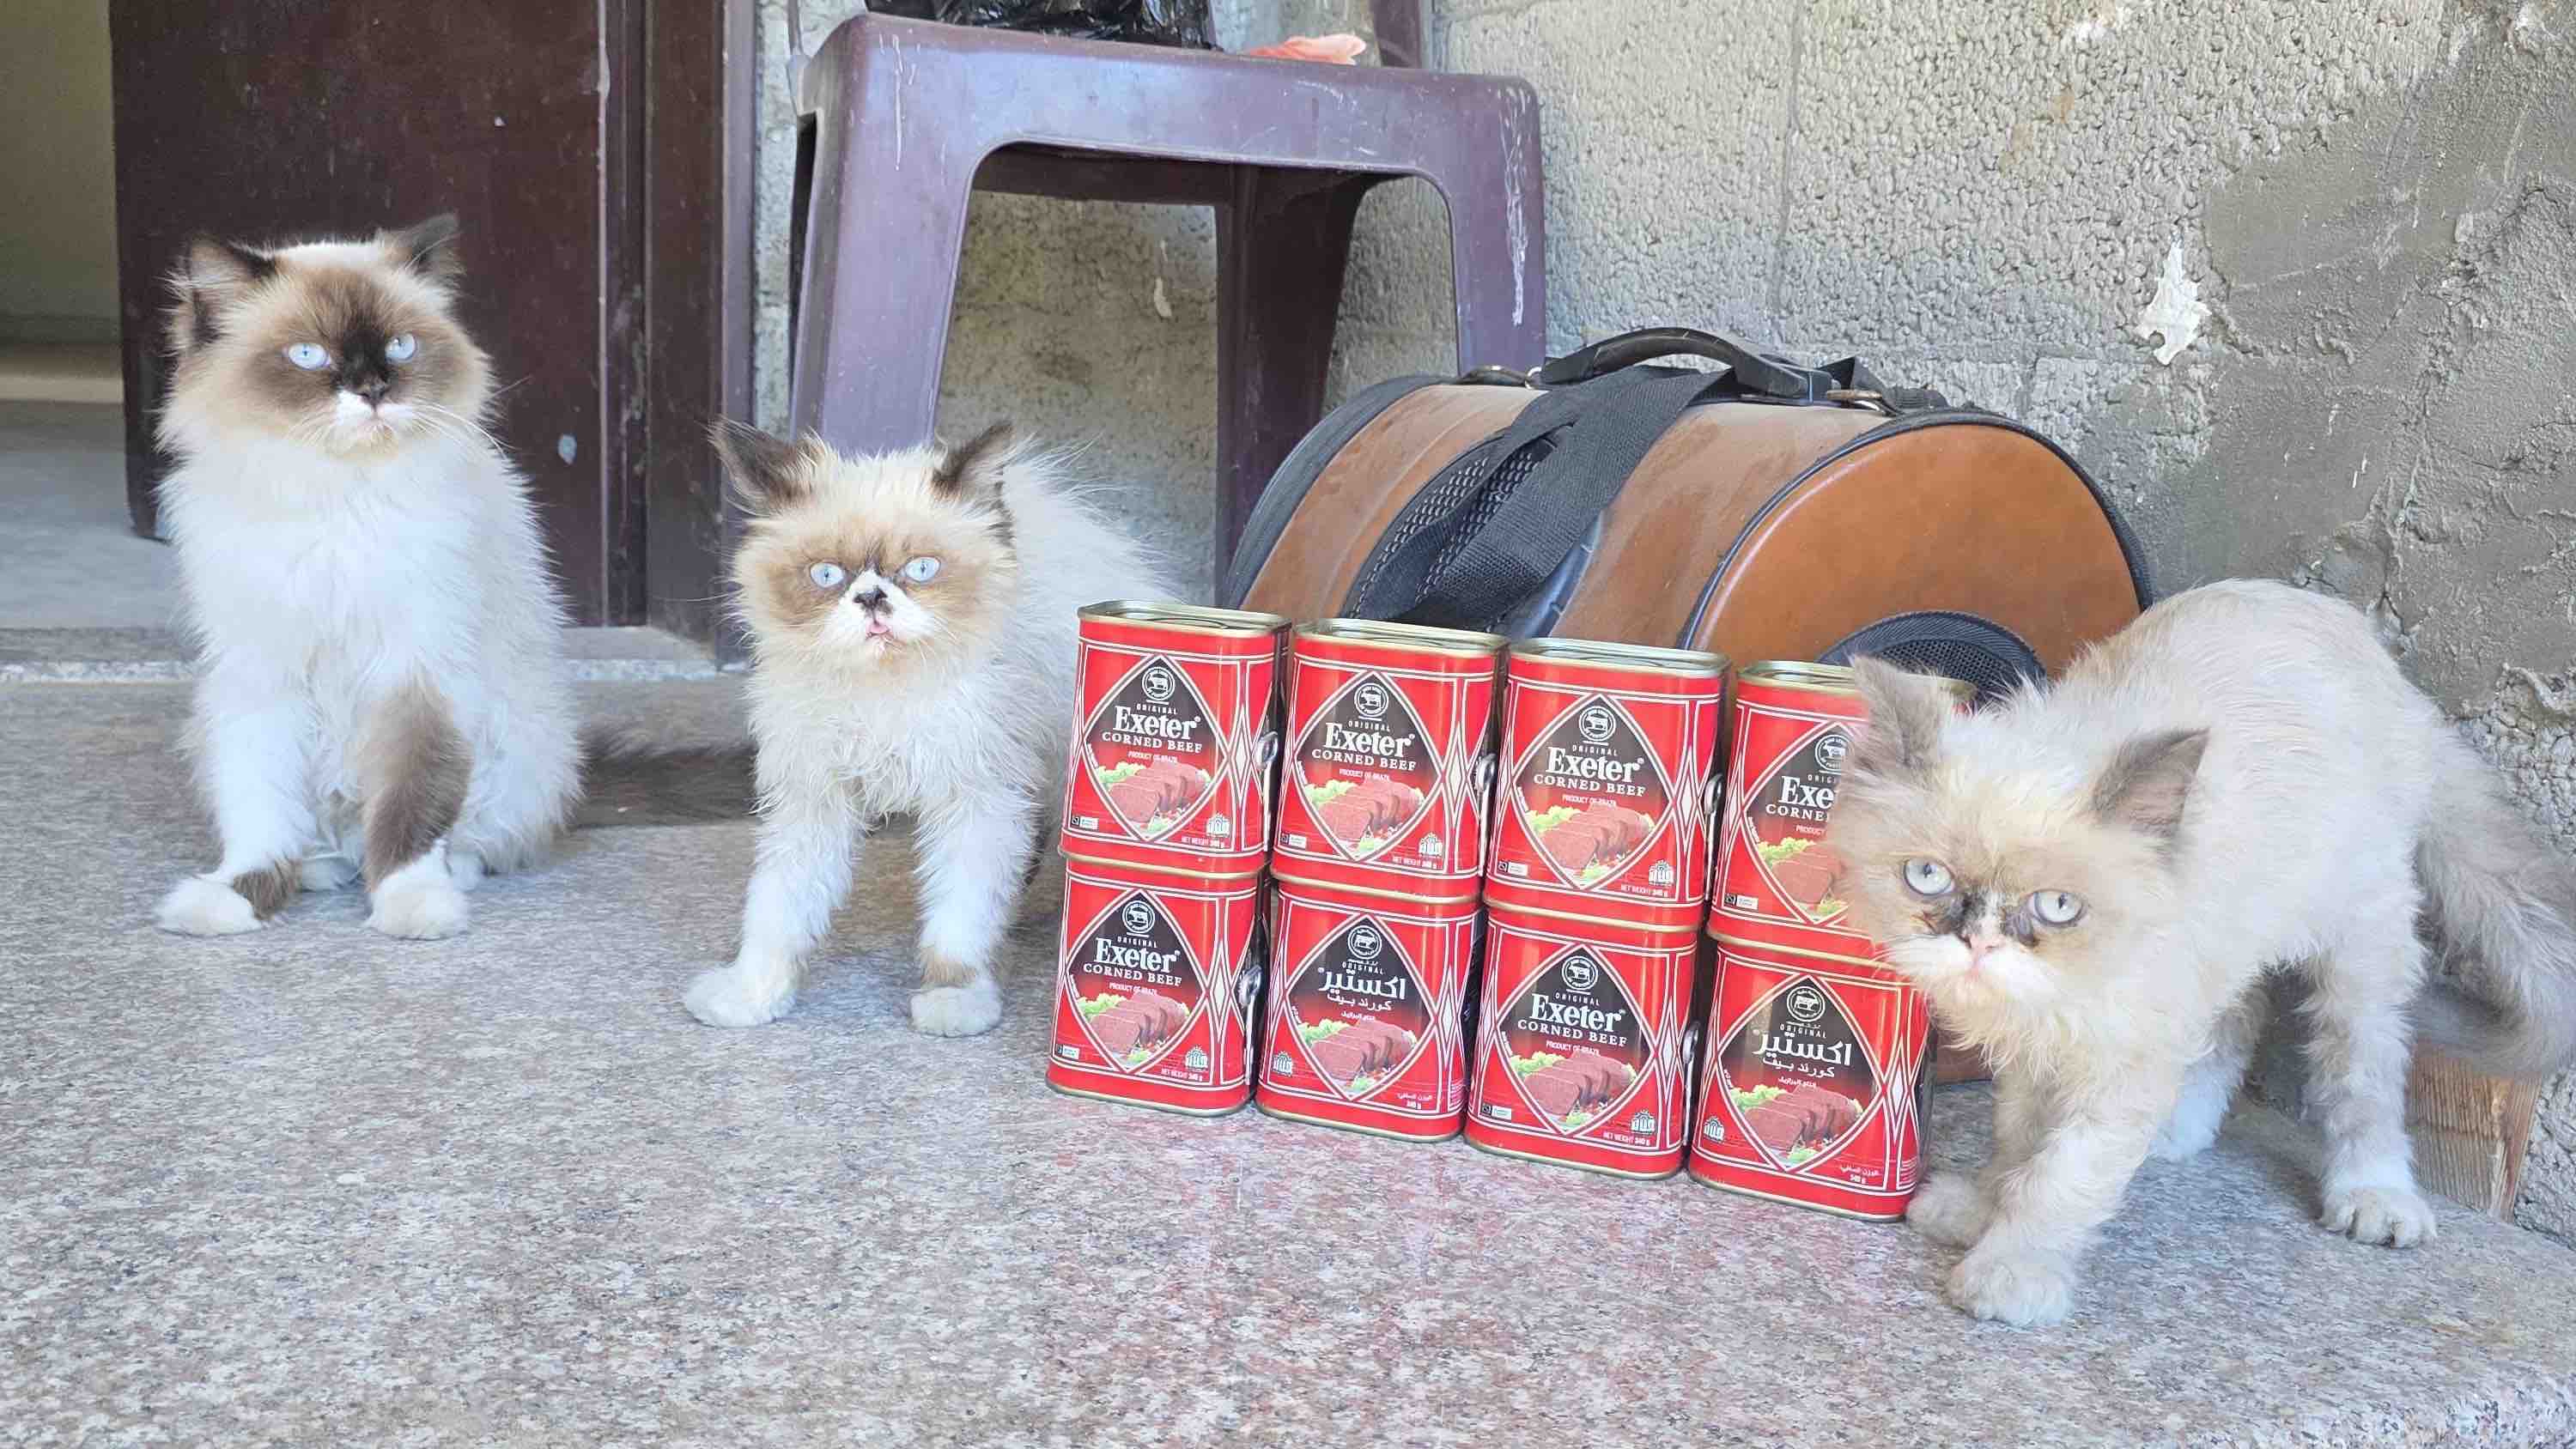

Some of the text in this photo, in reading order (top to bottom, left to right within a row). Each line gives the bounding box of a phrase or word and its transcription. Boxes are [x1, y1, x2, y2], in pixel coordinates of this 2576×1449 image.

[1136, 703, 1177, 715] ORIGINAL
[1113, 706, 1198, 740] Exeter
[1348, 720, 1390, 732] ORIGINAL
[1102, 731, 1202, 754] CORNED BEEF
[1322, 722, 1412, 757] Exeter
[1572, 744, 1618, 756] ORIGINAL
[1311, 749, 1417, 771] CORNED BEEF
[1546, 747, 1641, 783] Exeter
[1534, 773, 1646, 797] CORNED BEEF
[1807, 773, 1836, 784] ORIG
[1778, 776, 1838, 809] Exe
[1765, 803, 1827, 822] CORNE
[1117, 936, 1157, 948] ORIGINAL
[1094, 937, 1177, 973] Exeter
[1084, 963, 1182, 986] CORNED BEEF
[1342, 961, 1384, 975] ORIGINAL
[1555, 991, 1601, 1007] ORIGINAL
[1529, 993, 1622, 1033] Exeter
[1517, 1019, 1628, 1047] CORNED BEEF
[1780, 1023, 1827, 1039] ORIGINAL
[1546, 1040, 1571, 1052] PRODUCT
